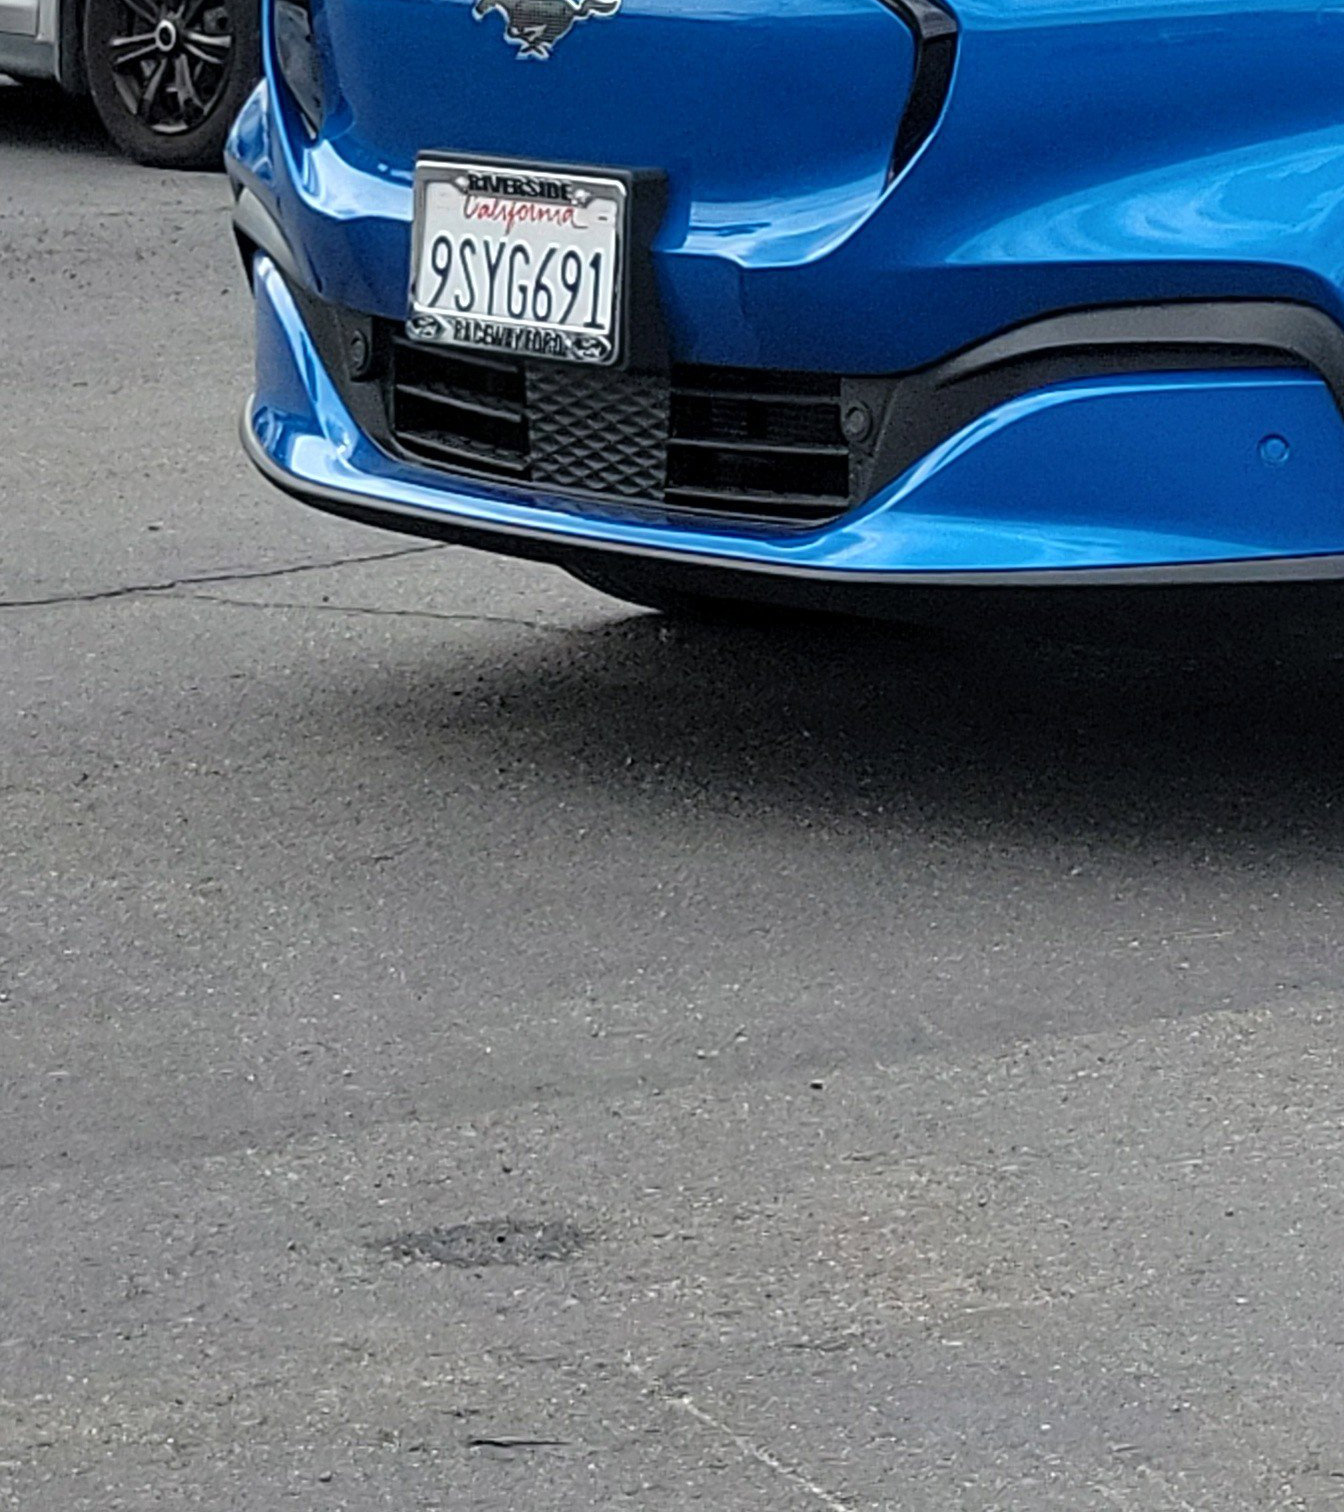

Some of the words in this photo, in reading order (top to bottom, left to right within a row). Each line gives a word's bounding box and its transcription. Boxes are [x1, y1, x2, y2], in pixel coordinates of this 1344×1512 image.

[467, 173, 573, 202] RIVERSIDE
[463, 193, 588, 235] California
[430, 234, 606, 330] 9SYG691
